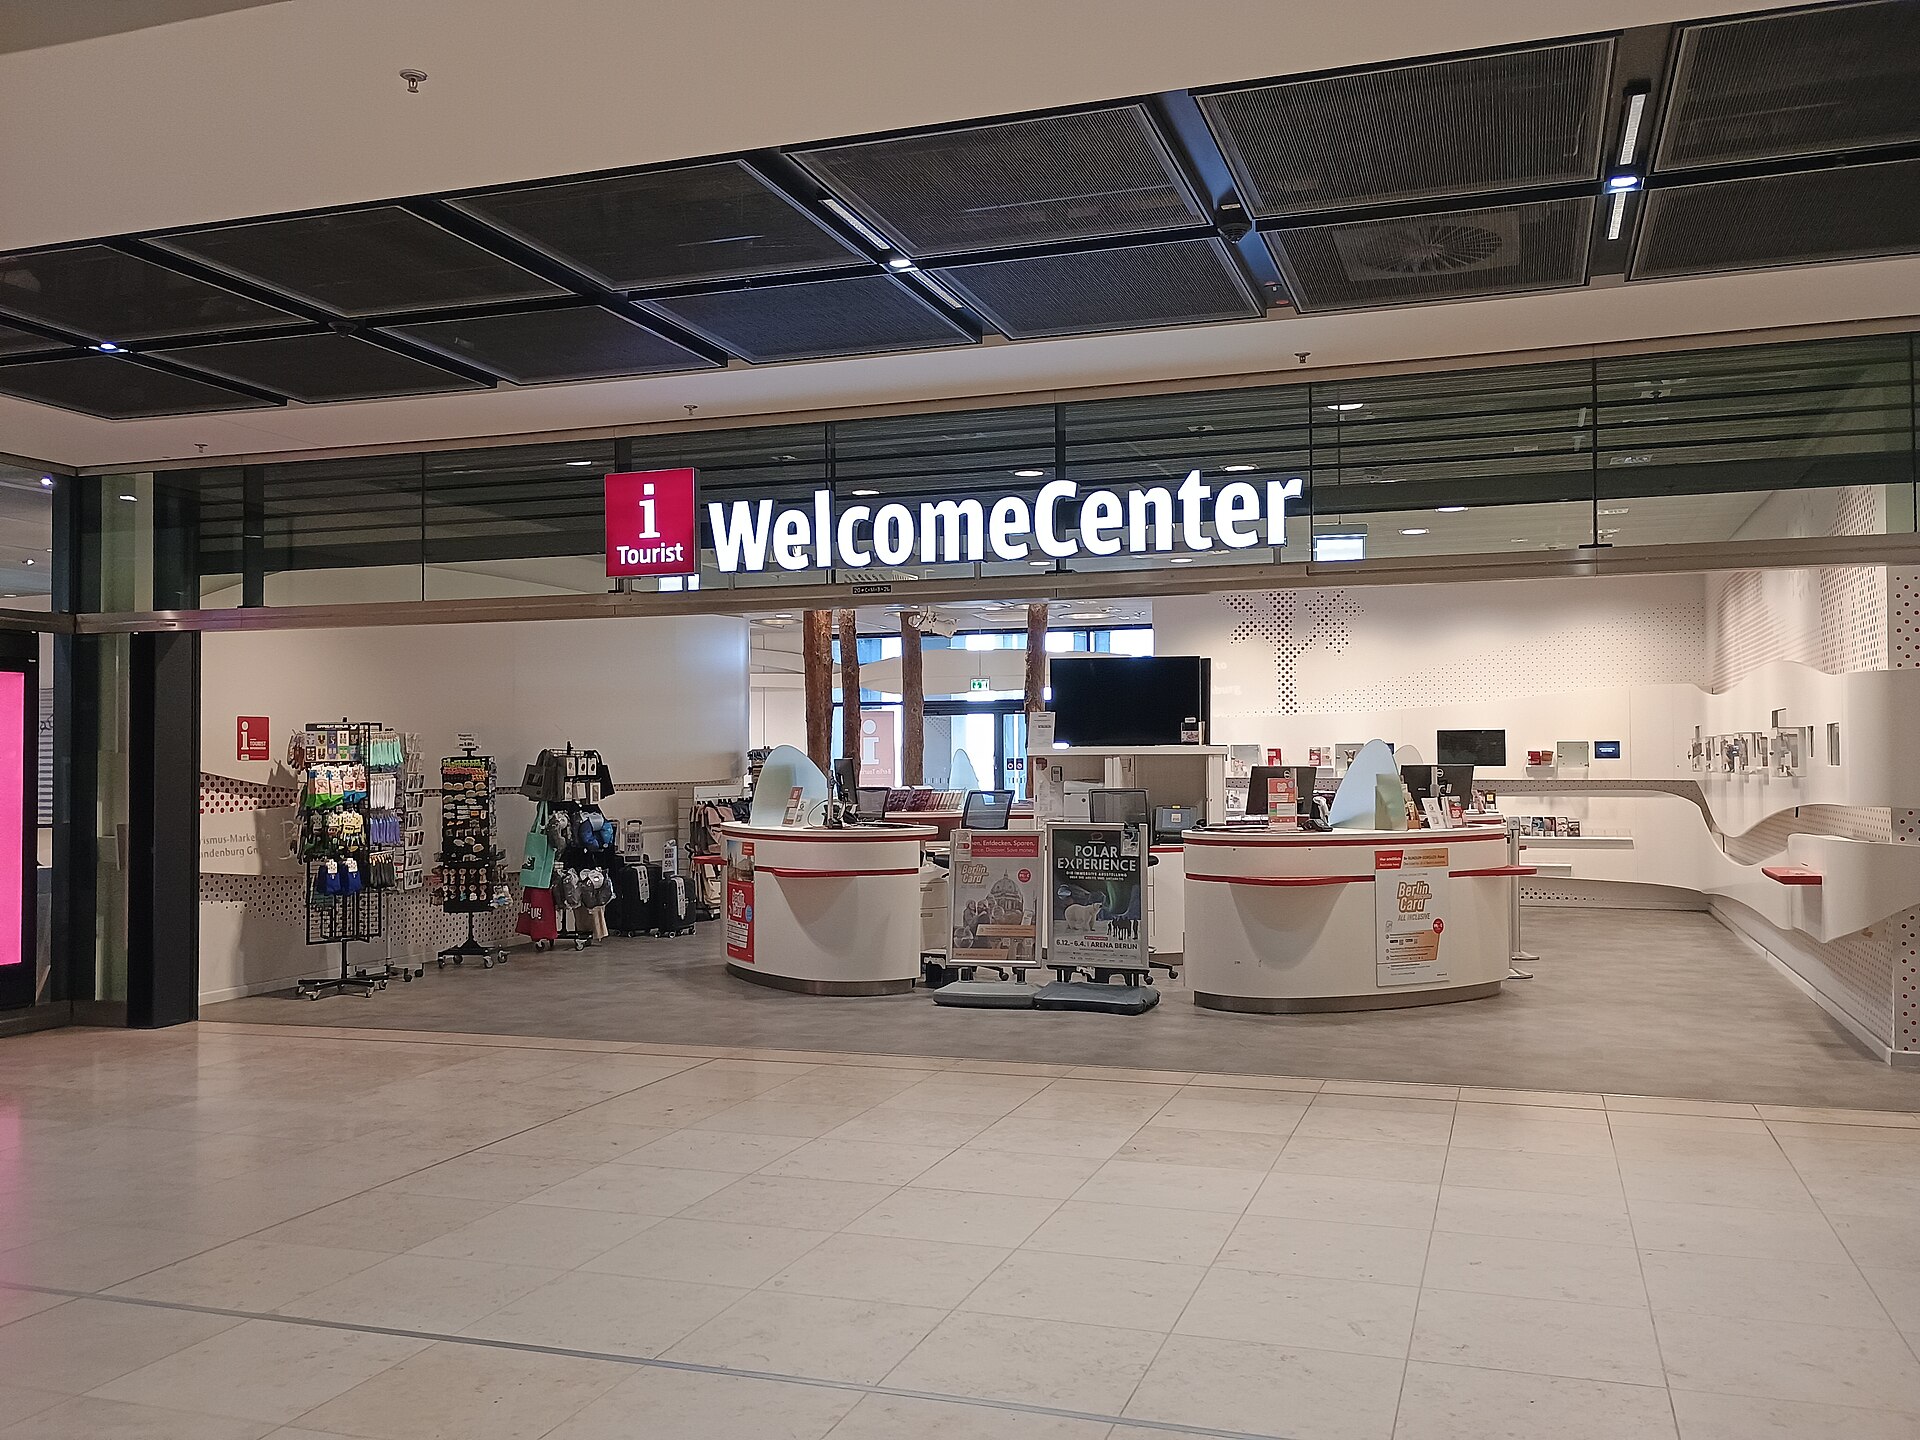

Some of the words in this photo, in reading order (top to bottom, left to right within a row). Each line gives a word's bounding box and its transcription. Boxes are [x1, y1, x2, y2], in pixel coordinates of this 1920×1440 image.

[638, 483, 661, 539] i
[707, 469, 1304, 573] WelcomeCenter
[616, 542, 684, 565] Tourist
[201, 833, 256, 845] ismus-Marke
[1013, 840, 1035, 848] Sparen.
[1075, 845, 1118, 858] POLAR
[1057, 858, 1137, 871] EXPERIENCE
[962, 874, 983, 884] Card
[1398, 881, 1429, 897] Berlin
[1399, 897, 1424, 911] Card
